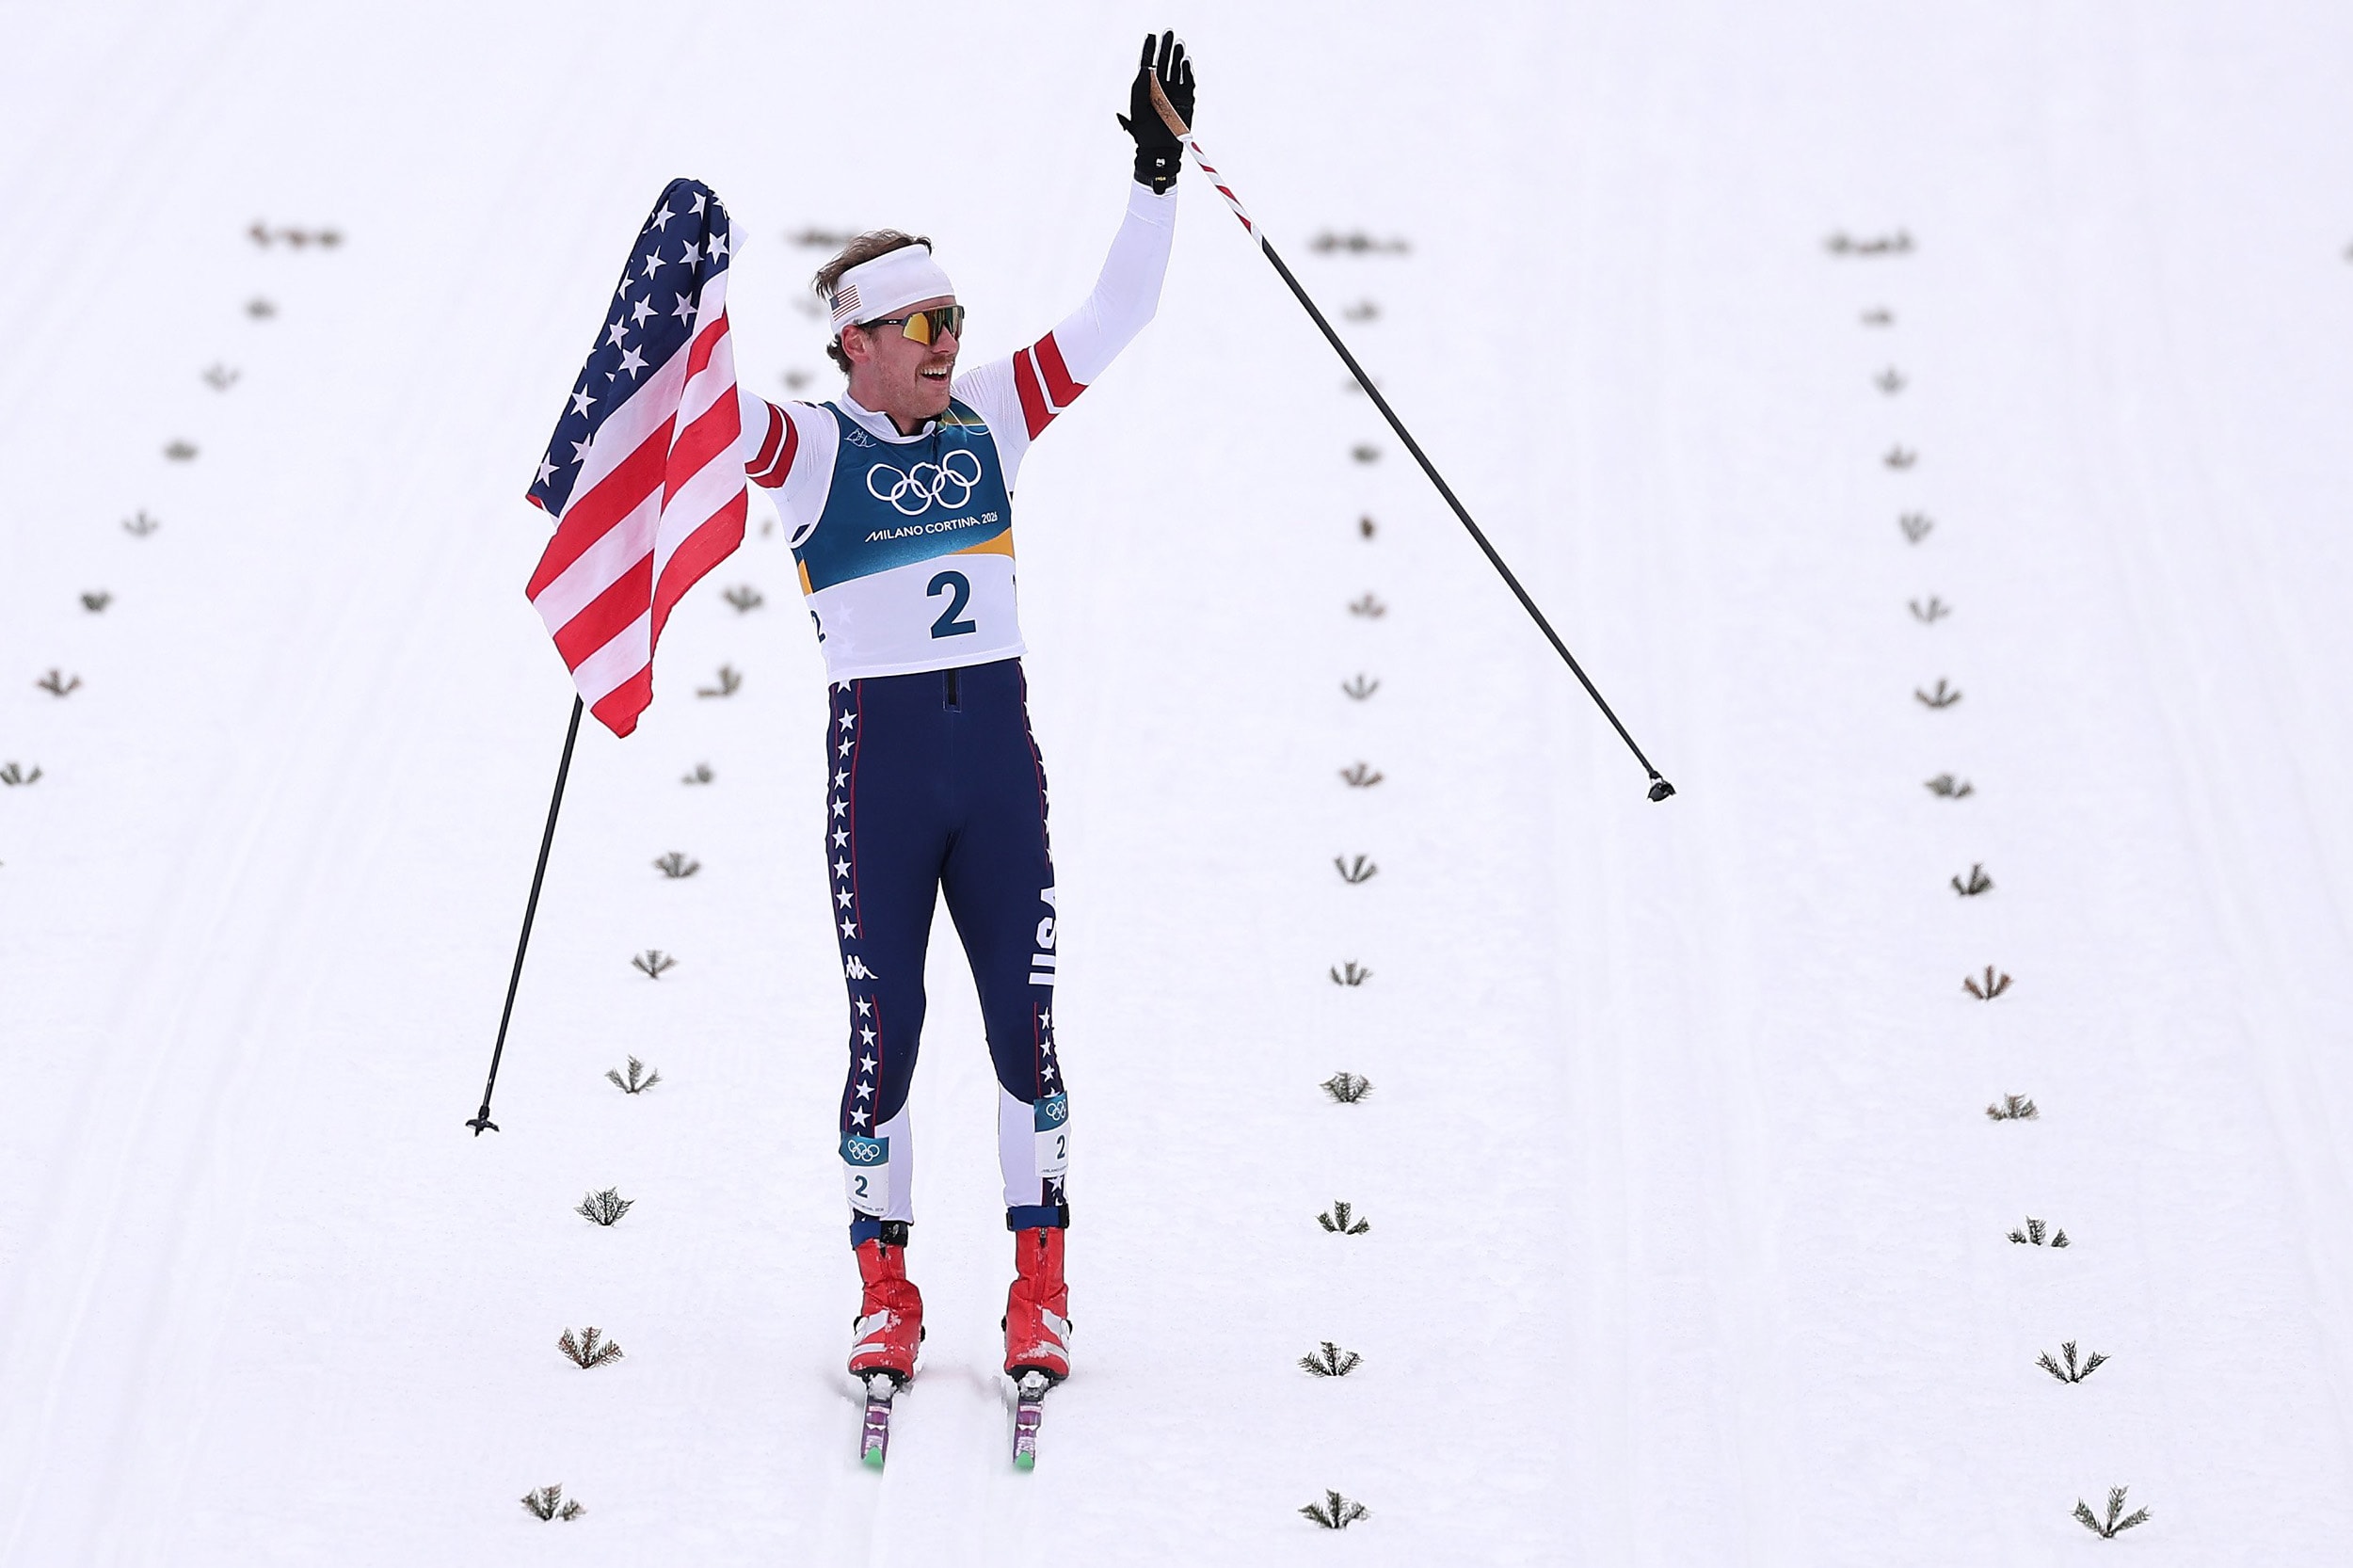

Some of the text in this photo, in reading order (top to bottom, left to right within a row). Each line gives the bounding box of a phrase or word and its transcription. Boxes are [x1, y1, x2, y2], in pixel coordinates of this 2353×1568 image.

[865, 511, 998, 542] MILANO CORTINA 2026
[927, 570, 976, 639] 2
[1057, 1134, 1065, 1160] 2
[855, 1175, 868, 1199] 2
